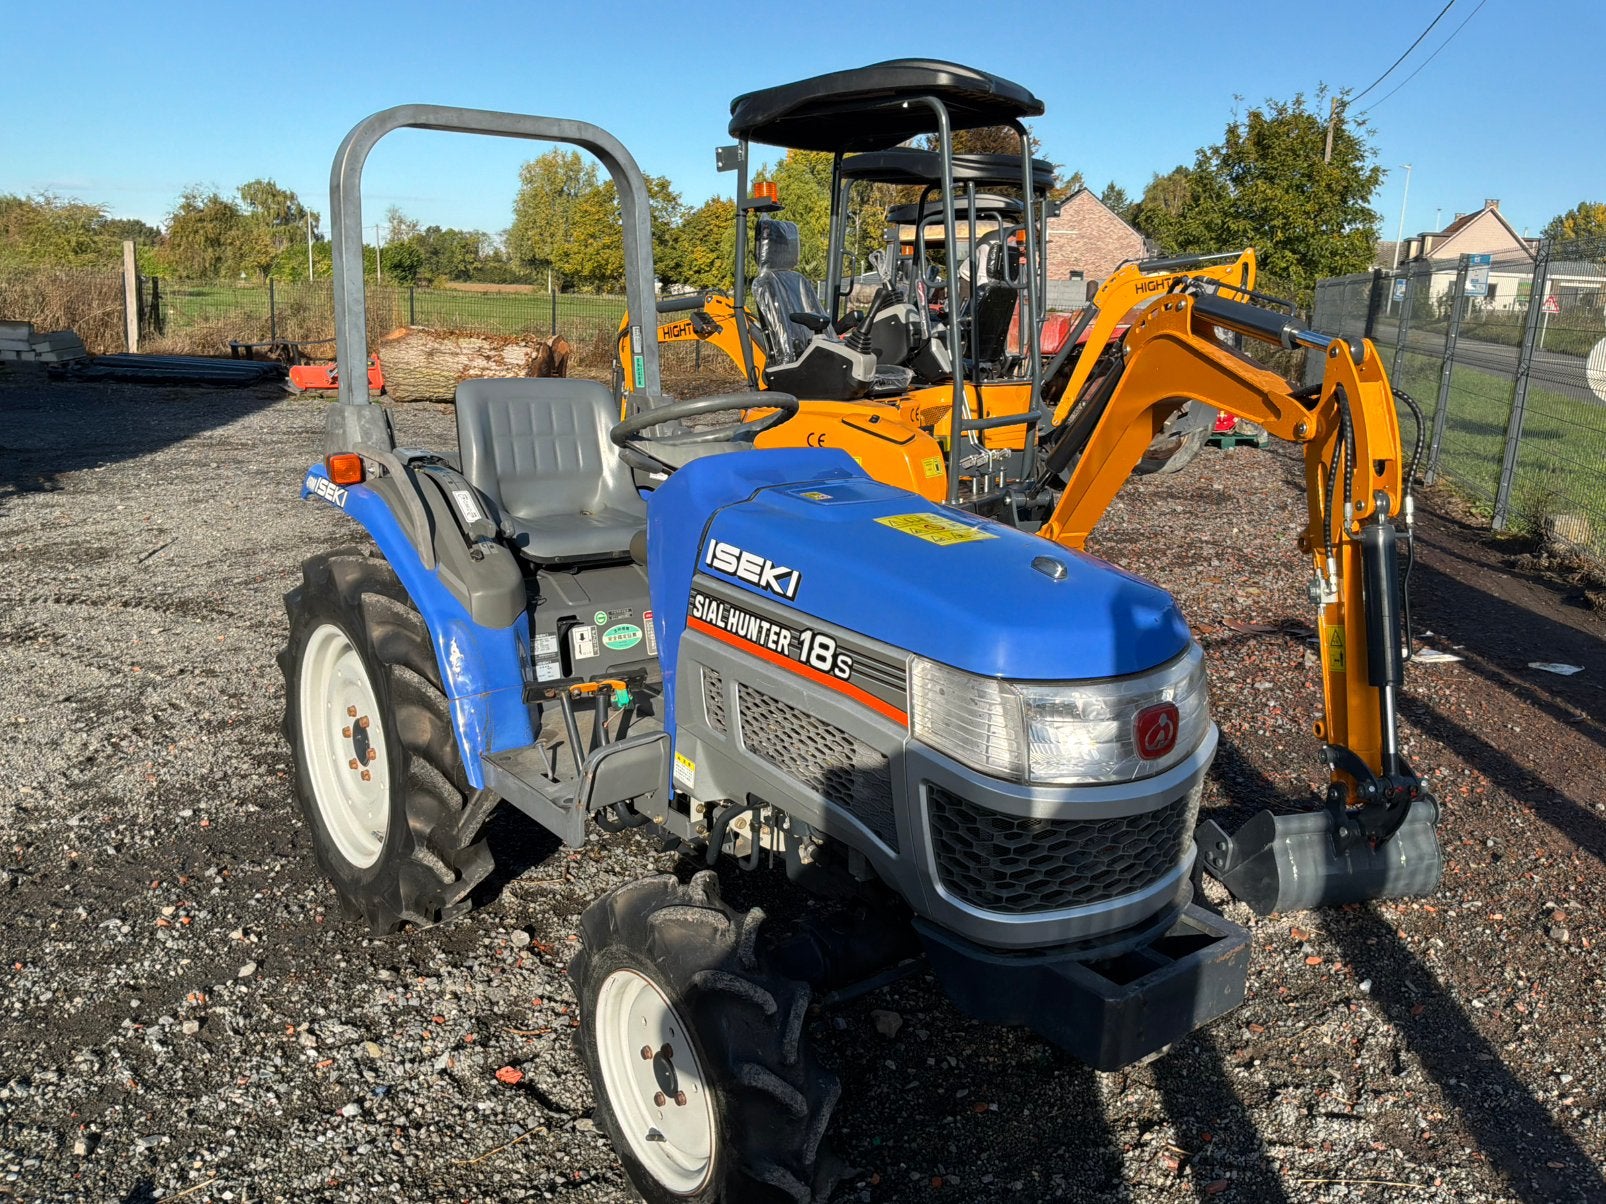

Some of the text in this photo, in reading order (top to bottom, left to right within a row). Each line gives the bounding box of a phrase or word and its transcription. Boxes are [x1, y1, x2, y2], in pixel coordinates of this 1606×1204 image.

[1135, 278, 1171, 294] HIGHT
[663, 323, 692, 339] HIGHT
[806, 432, 826, 448] CE
[314, 476, 348, 508] ISEKI
[705, 538, 801, 601] ISEKI
[692, 594, 726, 628] SIAL
[726, 608, 791, 656] HUNTER
